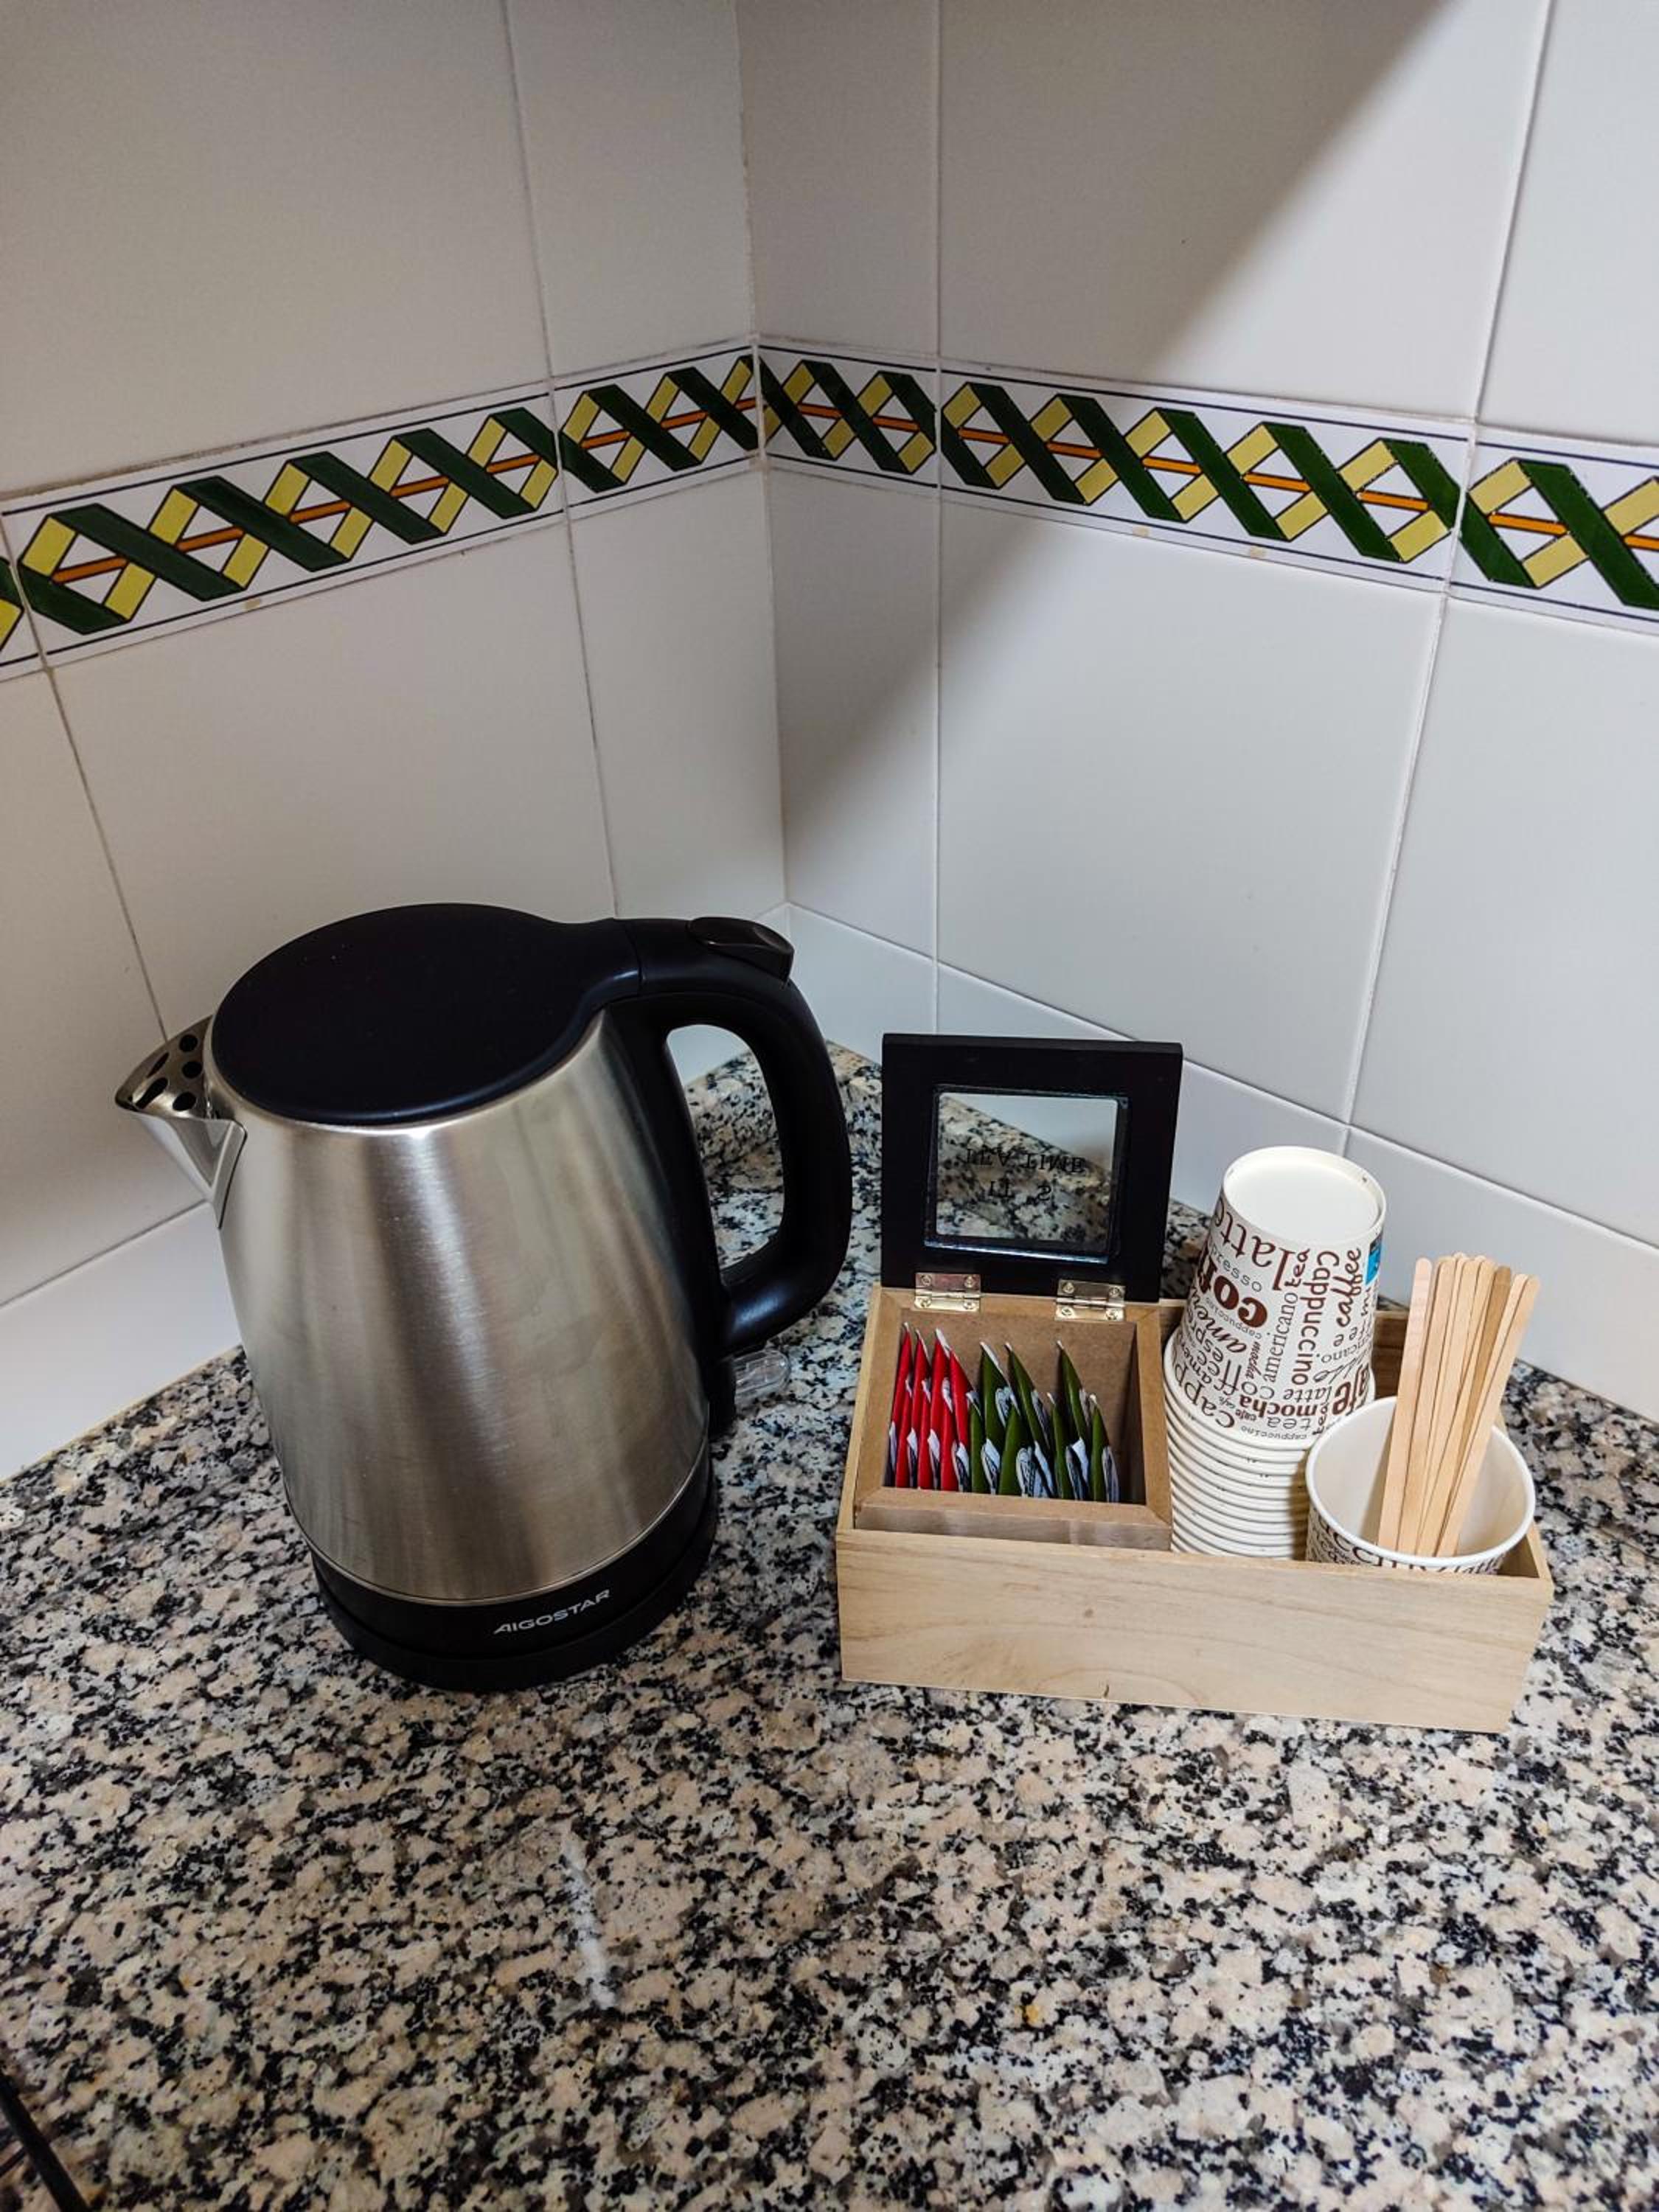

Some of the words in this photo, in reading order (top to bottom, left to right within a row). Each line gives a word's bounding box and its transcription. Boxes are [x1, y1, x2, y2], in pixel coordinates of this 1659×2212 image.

[1284, 1248, 1310, 1287] tea
[1262, 1292, 1298, 1383] americano
[1239, 1394, 1318, 1418] mocha
[1283, 1385, 1332, 1403] latte
[1267, 1417, 1311, 1430] tea
[493, 1588, 611, 1635] AIGOSTAR
